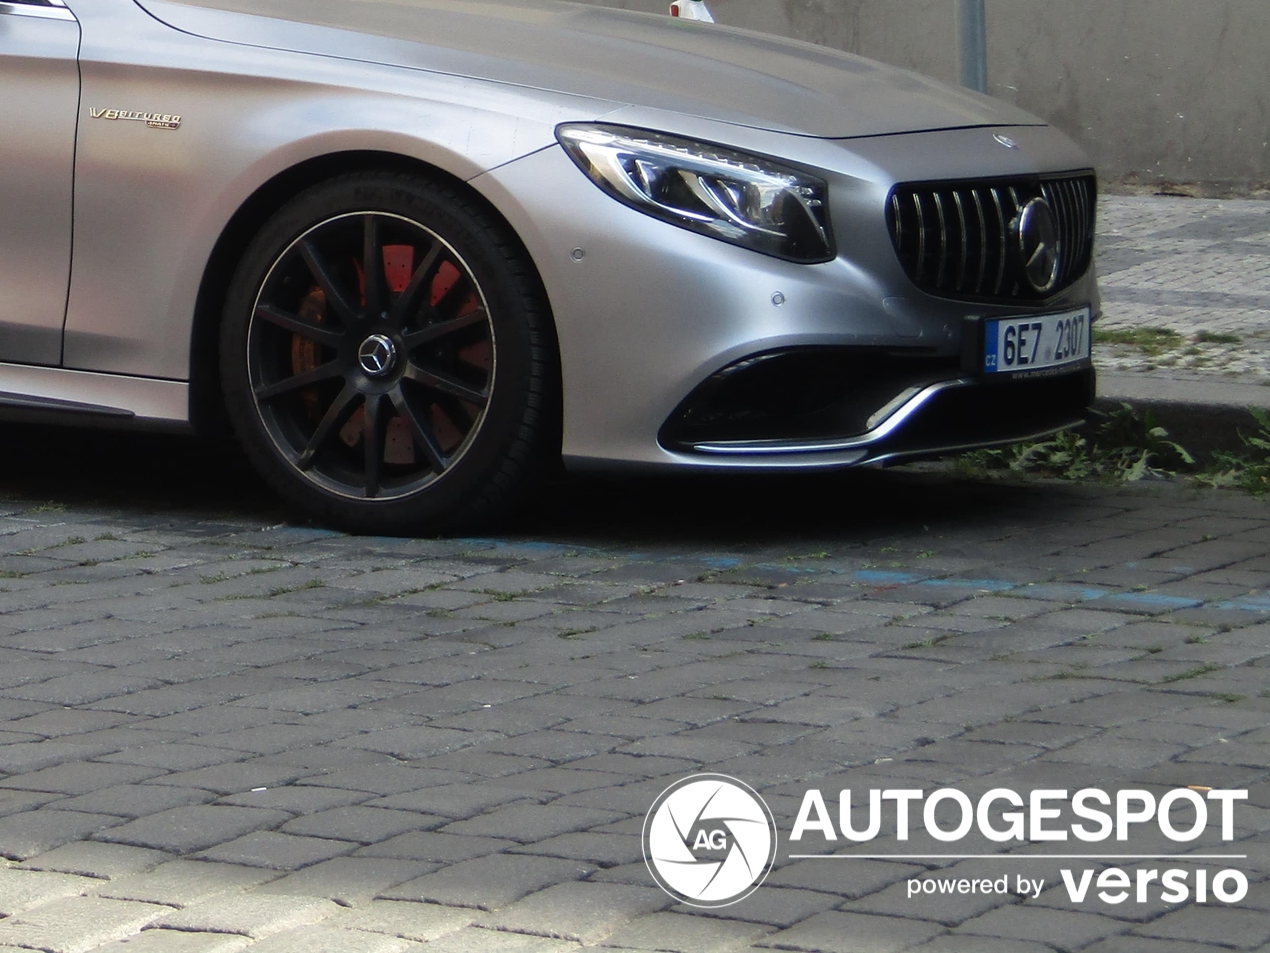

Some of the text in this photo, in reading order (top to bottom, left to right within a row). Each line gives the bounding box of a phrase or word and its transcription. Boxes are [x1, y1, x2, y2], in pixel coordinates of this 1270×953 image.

[1004, 314, 1085, 366] 6E7 2307
[985, 355, 996, 366] CZ
